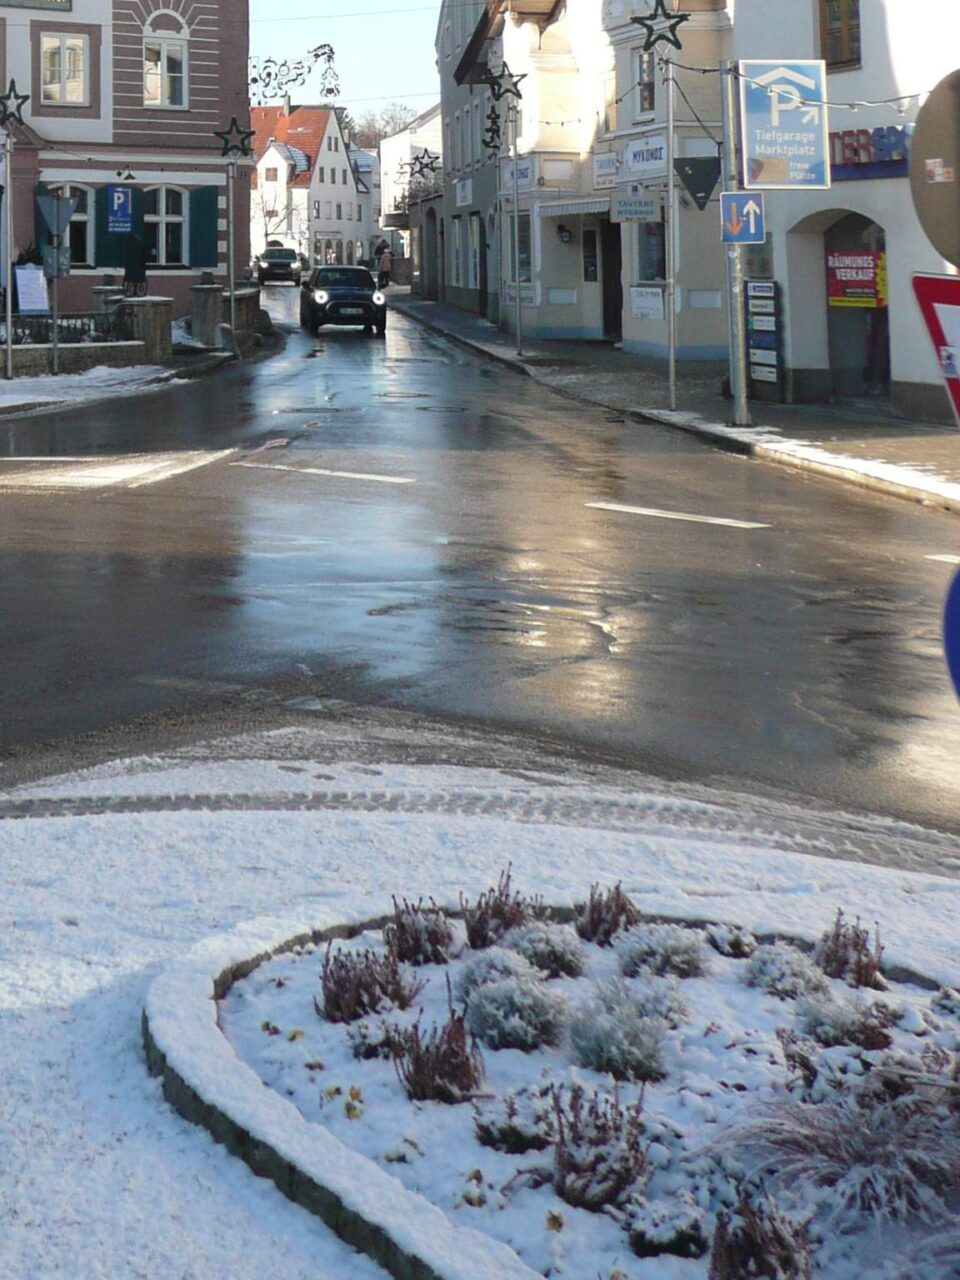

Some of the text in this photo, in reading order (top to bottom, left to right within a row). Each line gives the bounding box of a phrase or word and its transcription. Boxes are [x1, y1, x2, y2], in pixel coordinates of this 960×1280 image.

[755, 129, 816, 143] Tiefgarage
[755, 144, 816, 156] Marktplatz
[113, 192, 125, 210] P
[835, 268, 875, 281] VERKAUF
